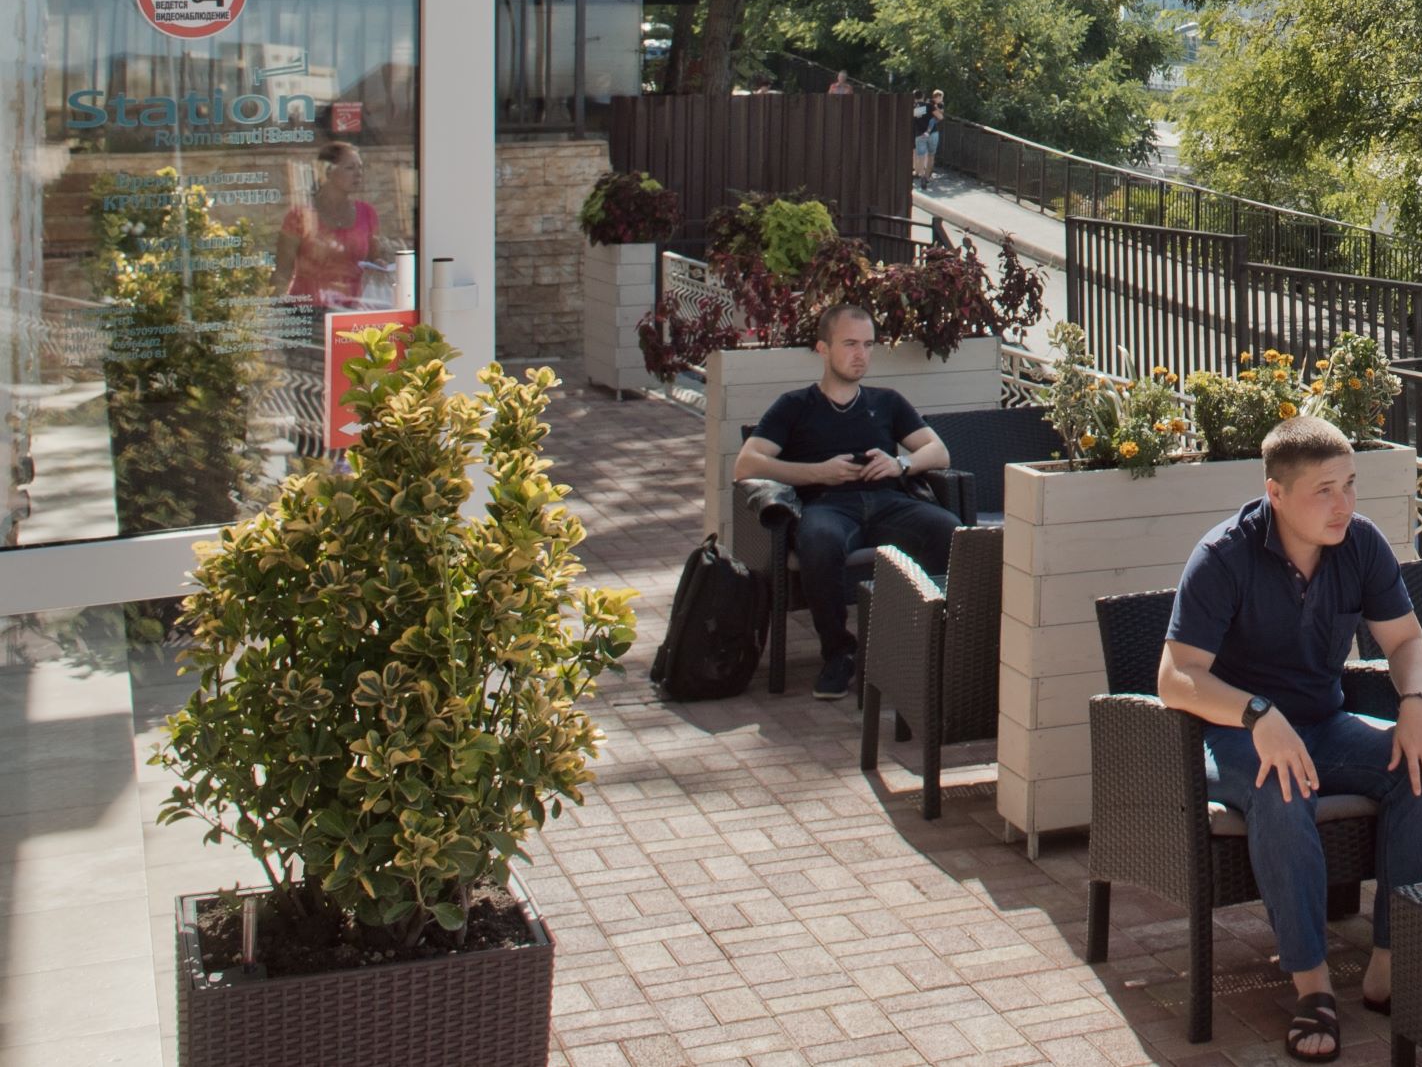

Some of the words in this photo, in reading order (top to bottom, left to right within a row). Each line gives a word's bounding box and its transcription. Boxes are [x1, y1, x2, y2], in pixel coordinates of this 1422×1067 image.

[155, 1, 188, 10] ВЕДЕТСЯ
[156, 11, 230, 22] ВИДЕОНАБЛЮДЕНИЕ
[66, 87, 316, 128] Station
